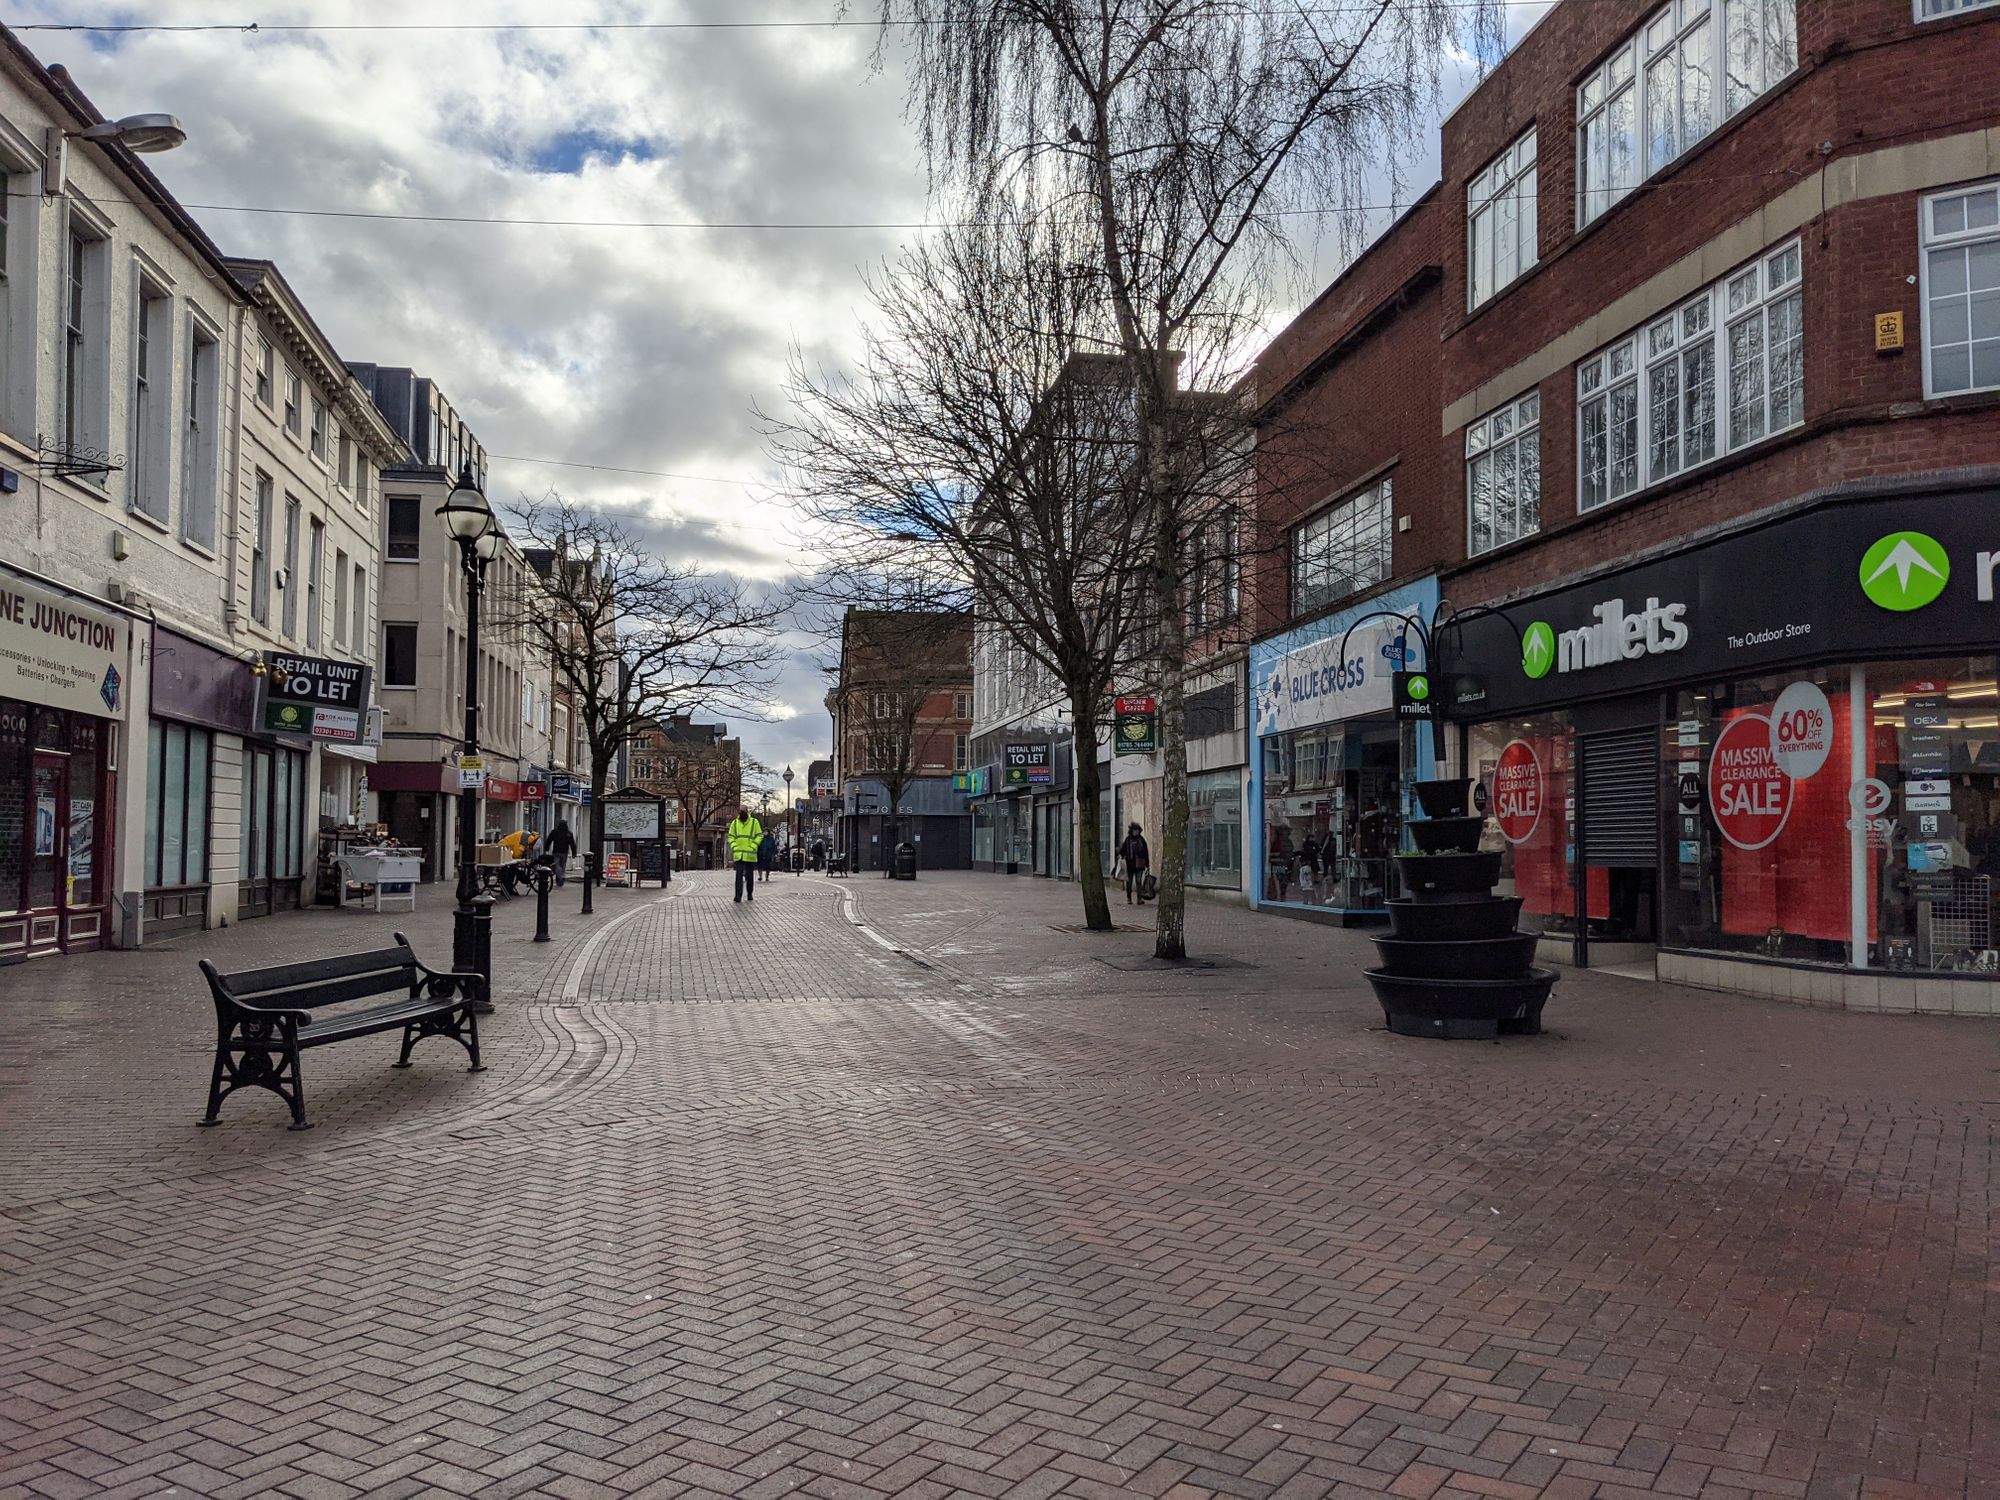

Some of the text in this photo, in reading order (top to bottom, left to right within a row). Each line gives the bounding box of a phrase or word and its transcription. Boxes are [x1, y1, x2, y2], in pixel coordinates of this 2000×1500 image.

[30, 602, 115, 653] JUNCTION
[1558, 597, 1688, 673] millets
[1727, 622, 1811, 649] The Outdoor Store
[17, 665, 76, 689] Batteries Chargers
[37, 656, 66, 674] Unlocking
[71, 665, 96, 683] Repairing
[276, 658, 359, 680] RETAIL UNIT
[283, 676, 351, 701] TO LET
[1292, 656, 1365, 703] BLUE CROSS
[1400, 702, 1432, 714] millet
[1778, 709, 1823, 743] 60%
[1913, 716, 1938, 725] OEX
[1808, 729, 1822, 740] OFF
[1031, 745, 1047, 753] UNIT
[1721, 747, 1776, 767] MASSIV
[1778, 742, 1823, 753] EVERYTHING
[1011, 753, 1044, 764] TO LET
[1500, 763, 1535, 779] MASSIVE
[1721, 766, 1782, 781] CLEARANCE
[1500, 779, 1536, 791] CLEARANCE
[1682, 782, 1699, 794] ALL
[1475, 791, 1486, 800] ALL
[1499, 791, 1536, 819] SALE
[1719, 781, 1782, 817] SALE
[877, 806, 913, 814] JOES
[1846, 818, 1899, 837] easy
